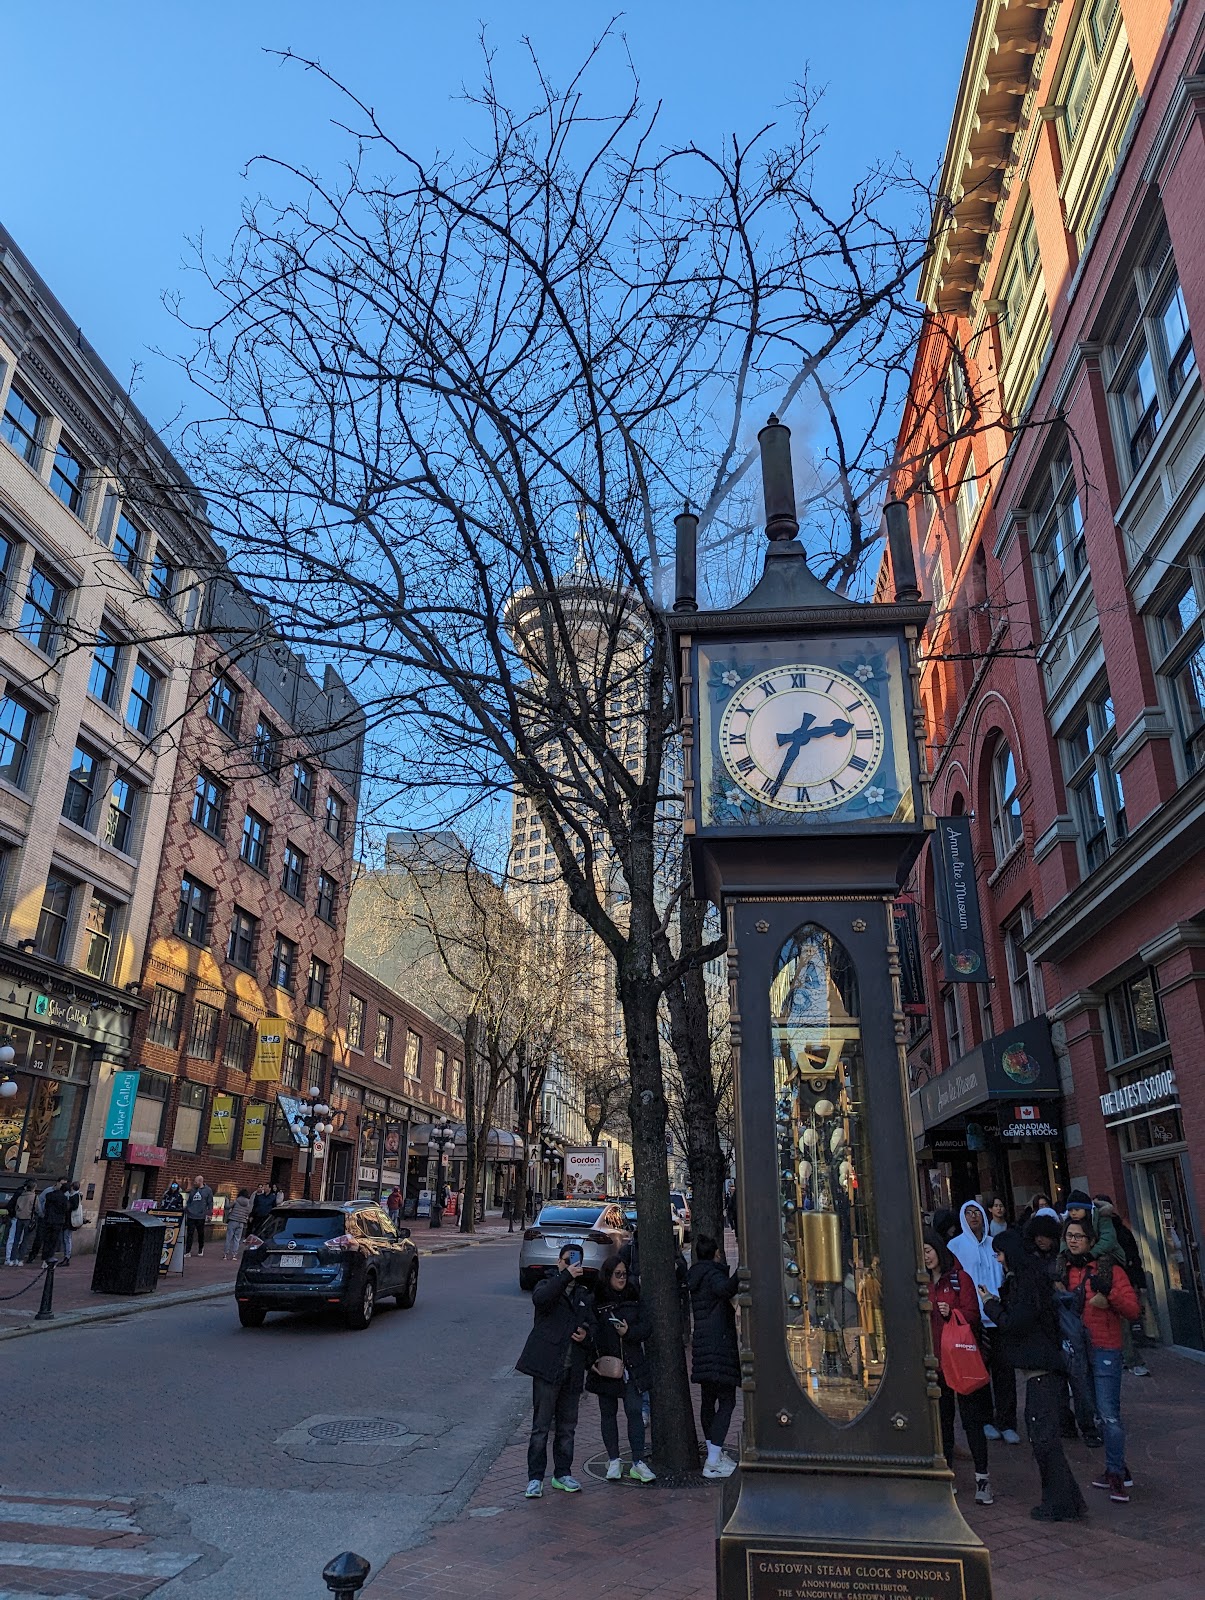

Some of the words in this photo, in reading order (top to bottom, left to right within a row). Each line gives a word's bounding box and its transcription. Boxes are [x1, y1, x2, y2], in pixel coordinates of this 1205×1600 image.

[790, 673, 806, 688] XII
[759, 680, 777, 698] XI
[735, 702, 754, 717] X
[846, 700, 863, 713] II
[856, 729, 873, 740] III
[830, 778, 845, 795] V
[954, 881, 968, 931] Museum
[48, 999, 66, 1019] Silver
[66, 1005, 89, 1028] Gallery
[33, 1060, 44, 1070] 312
[116, 1074, 135, 1107] Gallery
[1099, 1093, 1115, 1116] THE
[1114, 1081, 1143, 1112] LATEST
[1144, 1069, 1173, 1101] SCOOP
[111, 1109, 126, 1135] Silver
[1008, 1122, 1050, 1130] CANADIAN
[1003, 1129, 1026, 1137] GEMS
[1032, 1128, 1058, 1136] ROCKS
[570, 1156, 601, 1164] Gordon
[759, 1562, 813, 1574] GASTOWN
[817, 1564, 852, 1577] STEAM
[855, 1566, 892, 1579] CLOCK
[896, 1568, 951, 1582] SPONSORS
[801, 1580, 850, 1590] ANONYMOUS
[853, 1582, 909, 1593] CONTRIBUTOR
[778, 1589, 793, 1598] THE
[795, 1590, 844, 1600] VANCOUVER
[847, 1592, 886, 1600] GASTOWN
